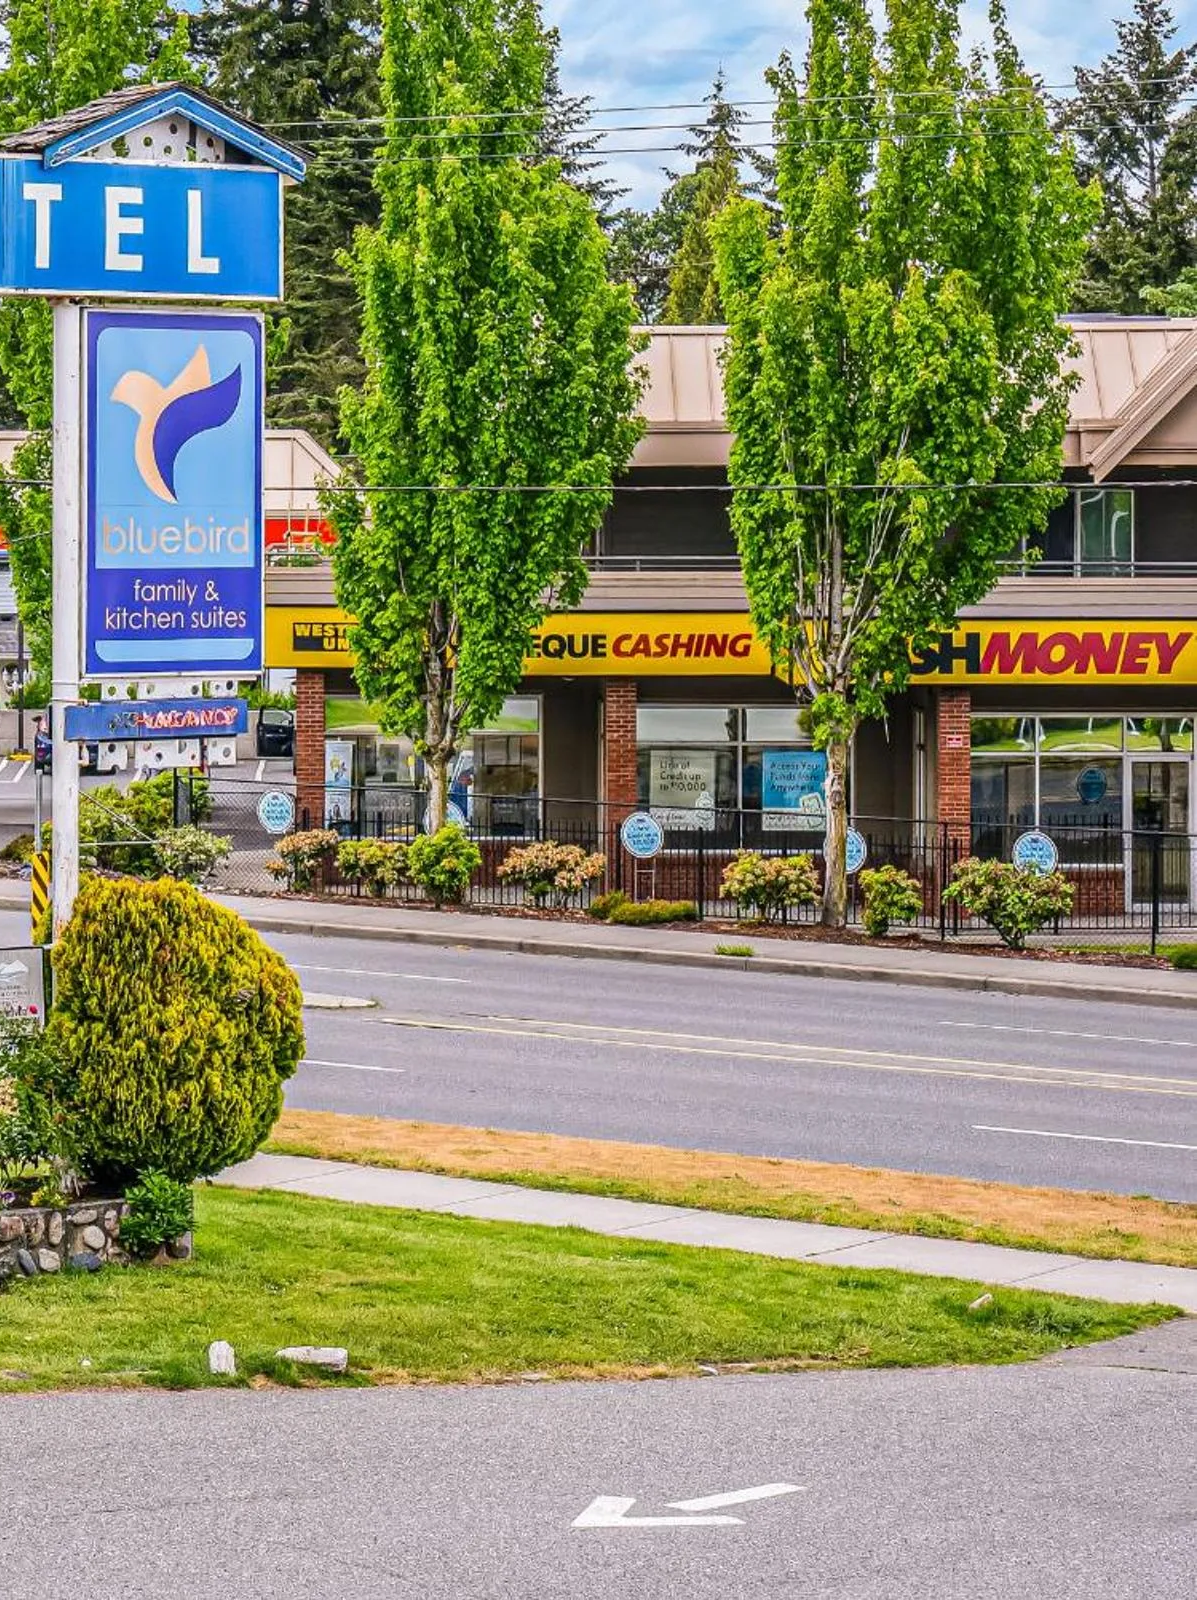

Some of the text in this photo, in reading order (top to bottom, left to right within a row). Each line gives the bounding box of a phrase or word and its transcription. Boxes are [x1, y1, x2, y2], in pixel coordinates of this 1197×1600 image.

[102, 515, 250, 556] bluebird
[133, 578, 220, 606] family &
[105, 605, 247, 630] kitchen suites
[294, 623, 349, 637] WEST
[528, 632, 753, 659] EQUE CASHING
[140, 705, 239, 730] VACANCY
